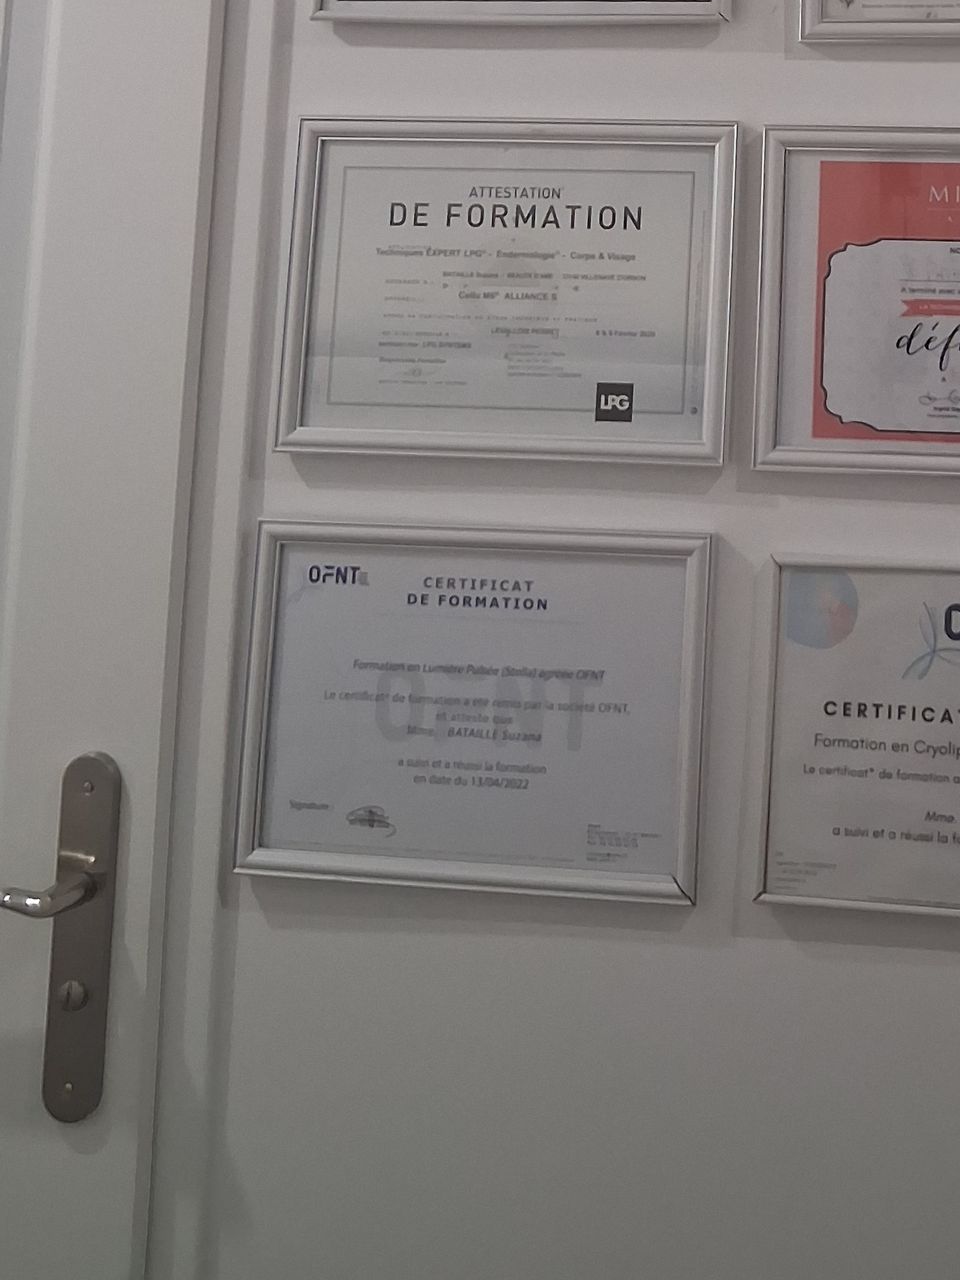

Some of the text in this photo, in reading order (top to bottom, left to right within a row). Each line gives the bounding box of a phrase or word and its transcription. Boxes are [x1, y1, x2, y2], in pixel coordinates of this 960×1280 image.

[469, 186, 561, 200] ATTESTATION
[389, 202, 643, 231] DE FORMATION
[600, 393, 630, 411] LPG
[308, 565, 361, 585] OFNT
[423, 576, 535, 593] CERTIFICAT
[407, 593, 548, 612] DE FORMATION
[391, 692, 406, 703] de
[447, 726, 498, 741] BATAILLE
[814, 732, 887, 752] Formation
[891, 741, 910, 754] en
[803, 765, 816, 776] Le
[878, 769, 893, 781] de
[896, 770, 950, 785] formation
[953, 775, 960, 785] a
[832, 826, 840, 836] a
[872, 827, 886, 839] et
[888, 830, 897, 840] a
[936, 830, 949, 844] la
